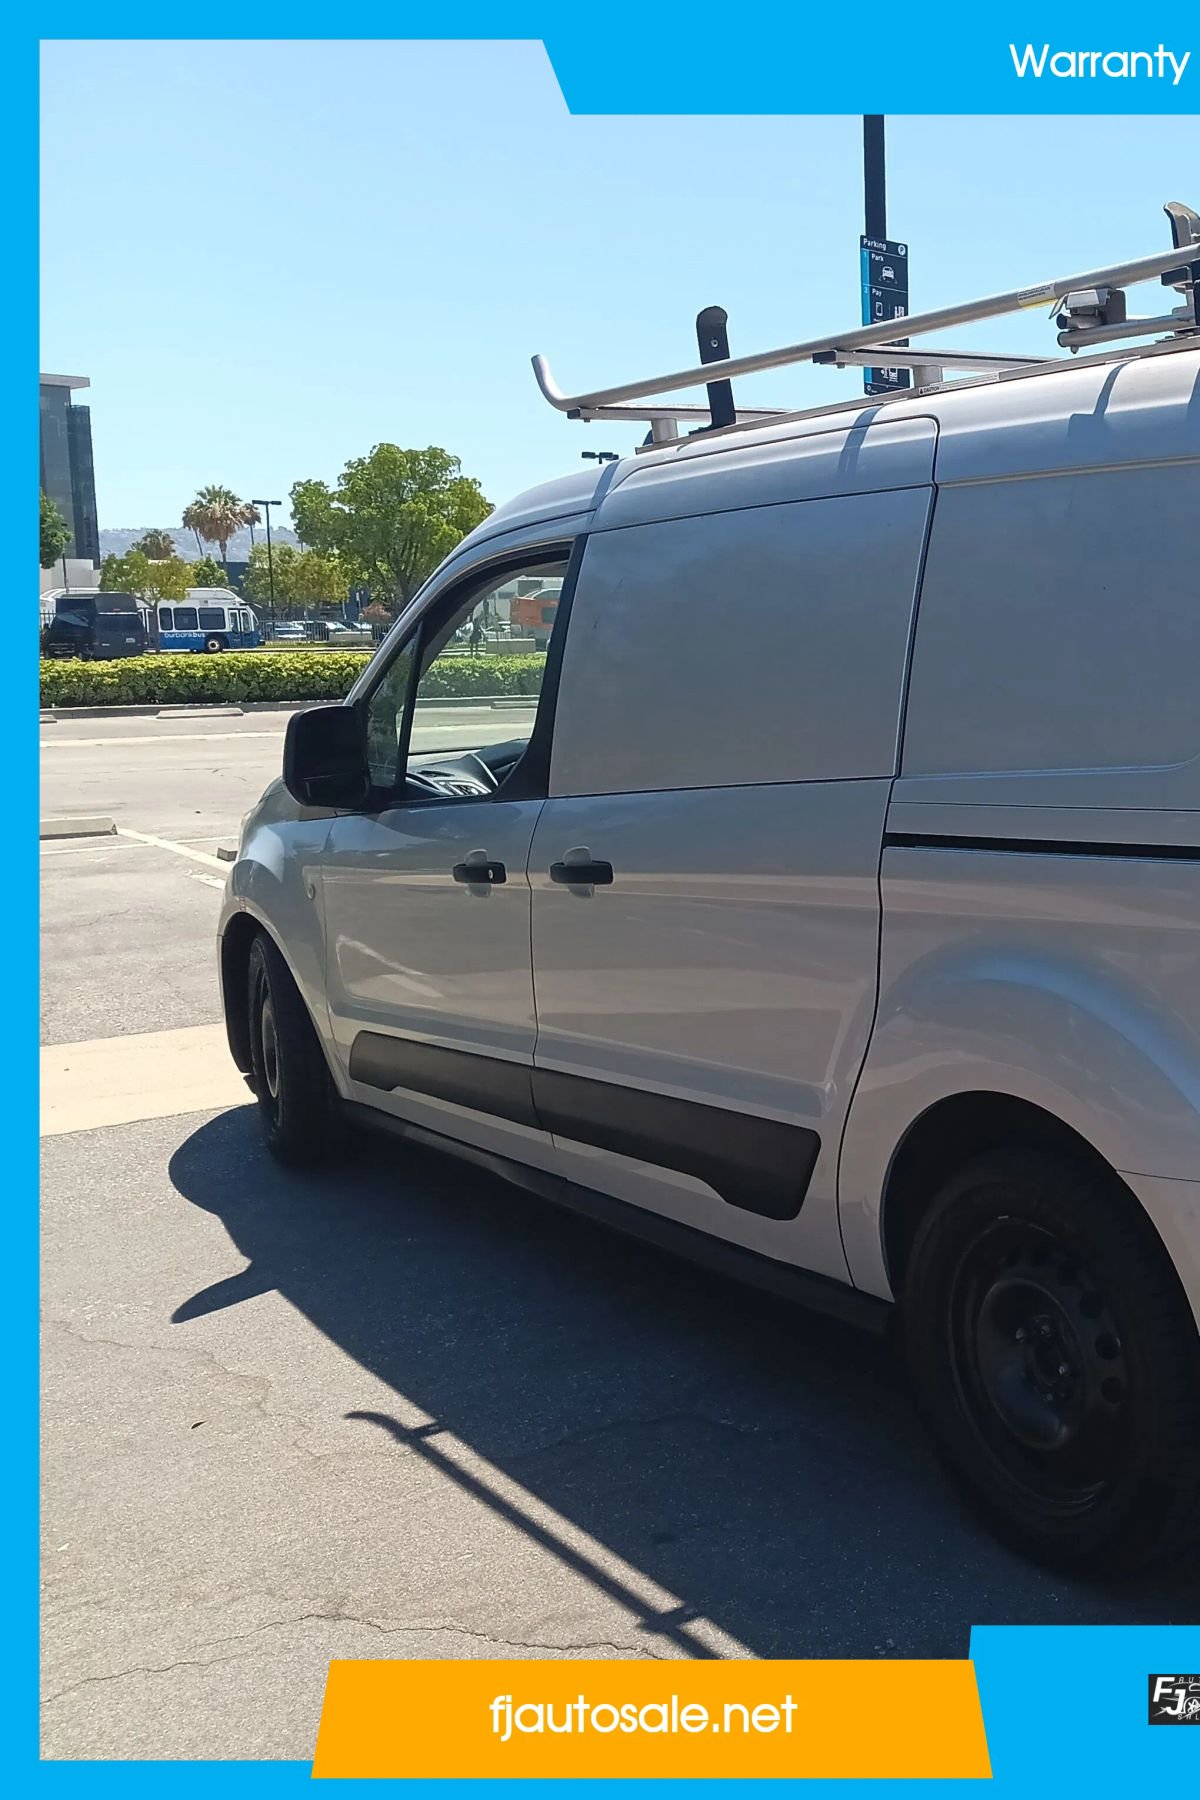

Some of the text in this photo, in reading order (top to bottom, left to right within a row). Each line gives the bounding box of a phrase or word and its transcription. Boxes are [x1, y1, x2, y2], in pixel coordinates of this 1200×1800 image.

[863, 238, 887, 251] Parking
[871, 253, 884, 262] Park
[871, 288, 882, 297] Pay
